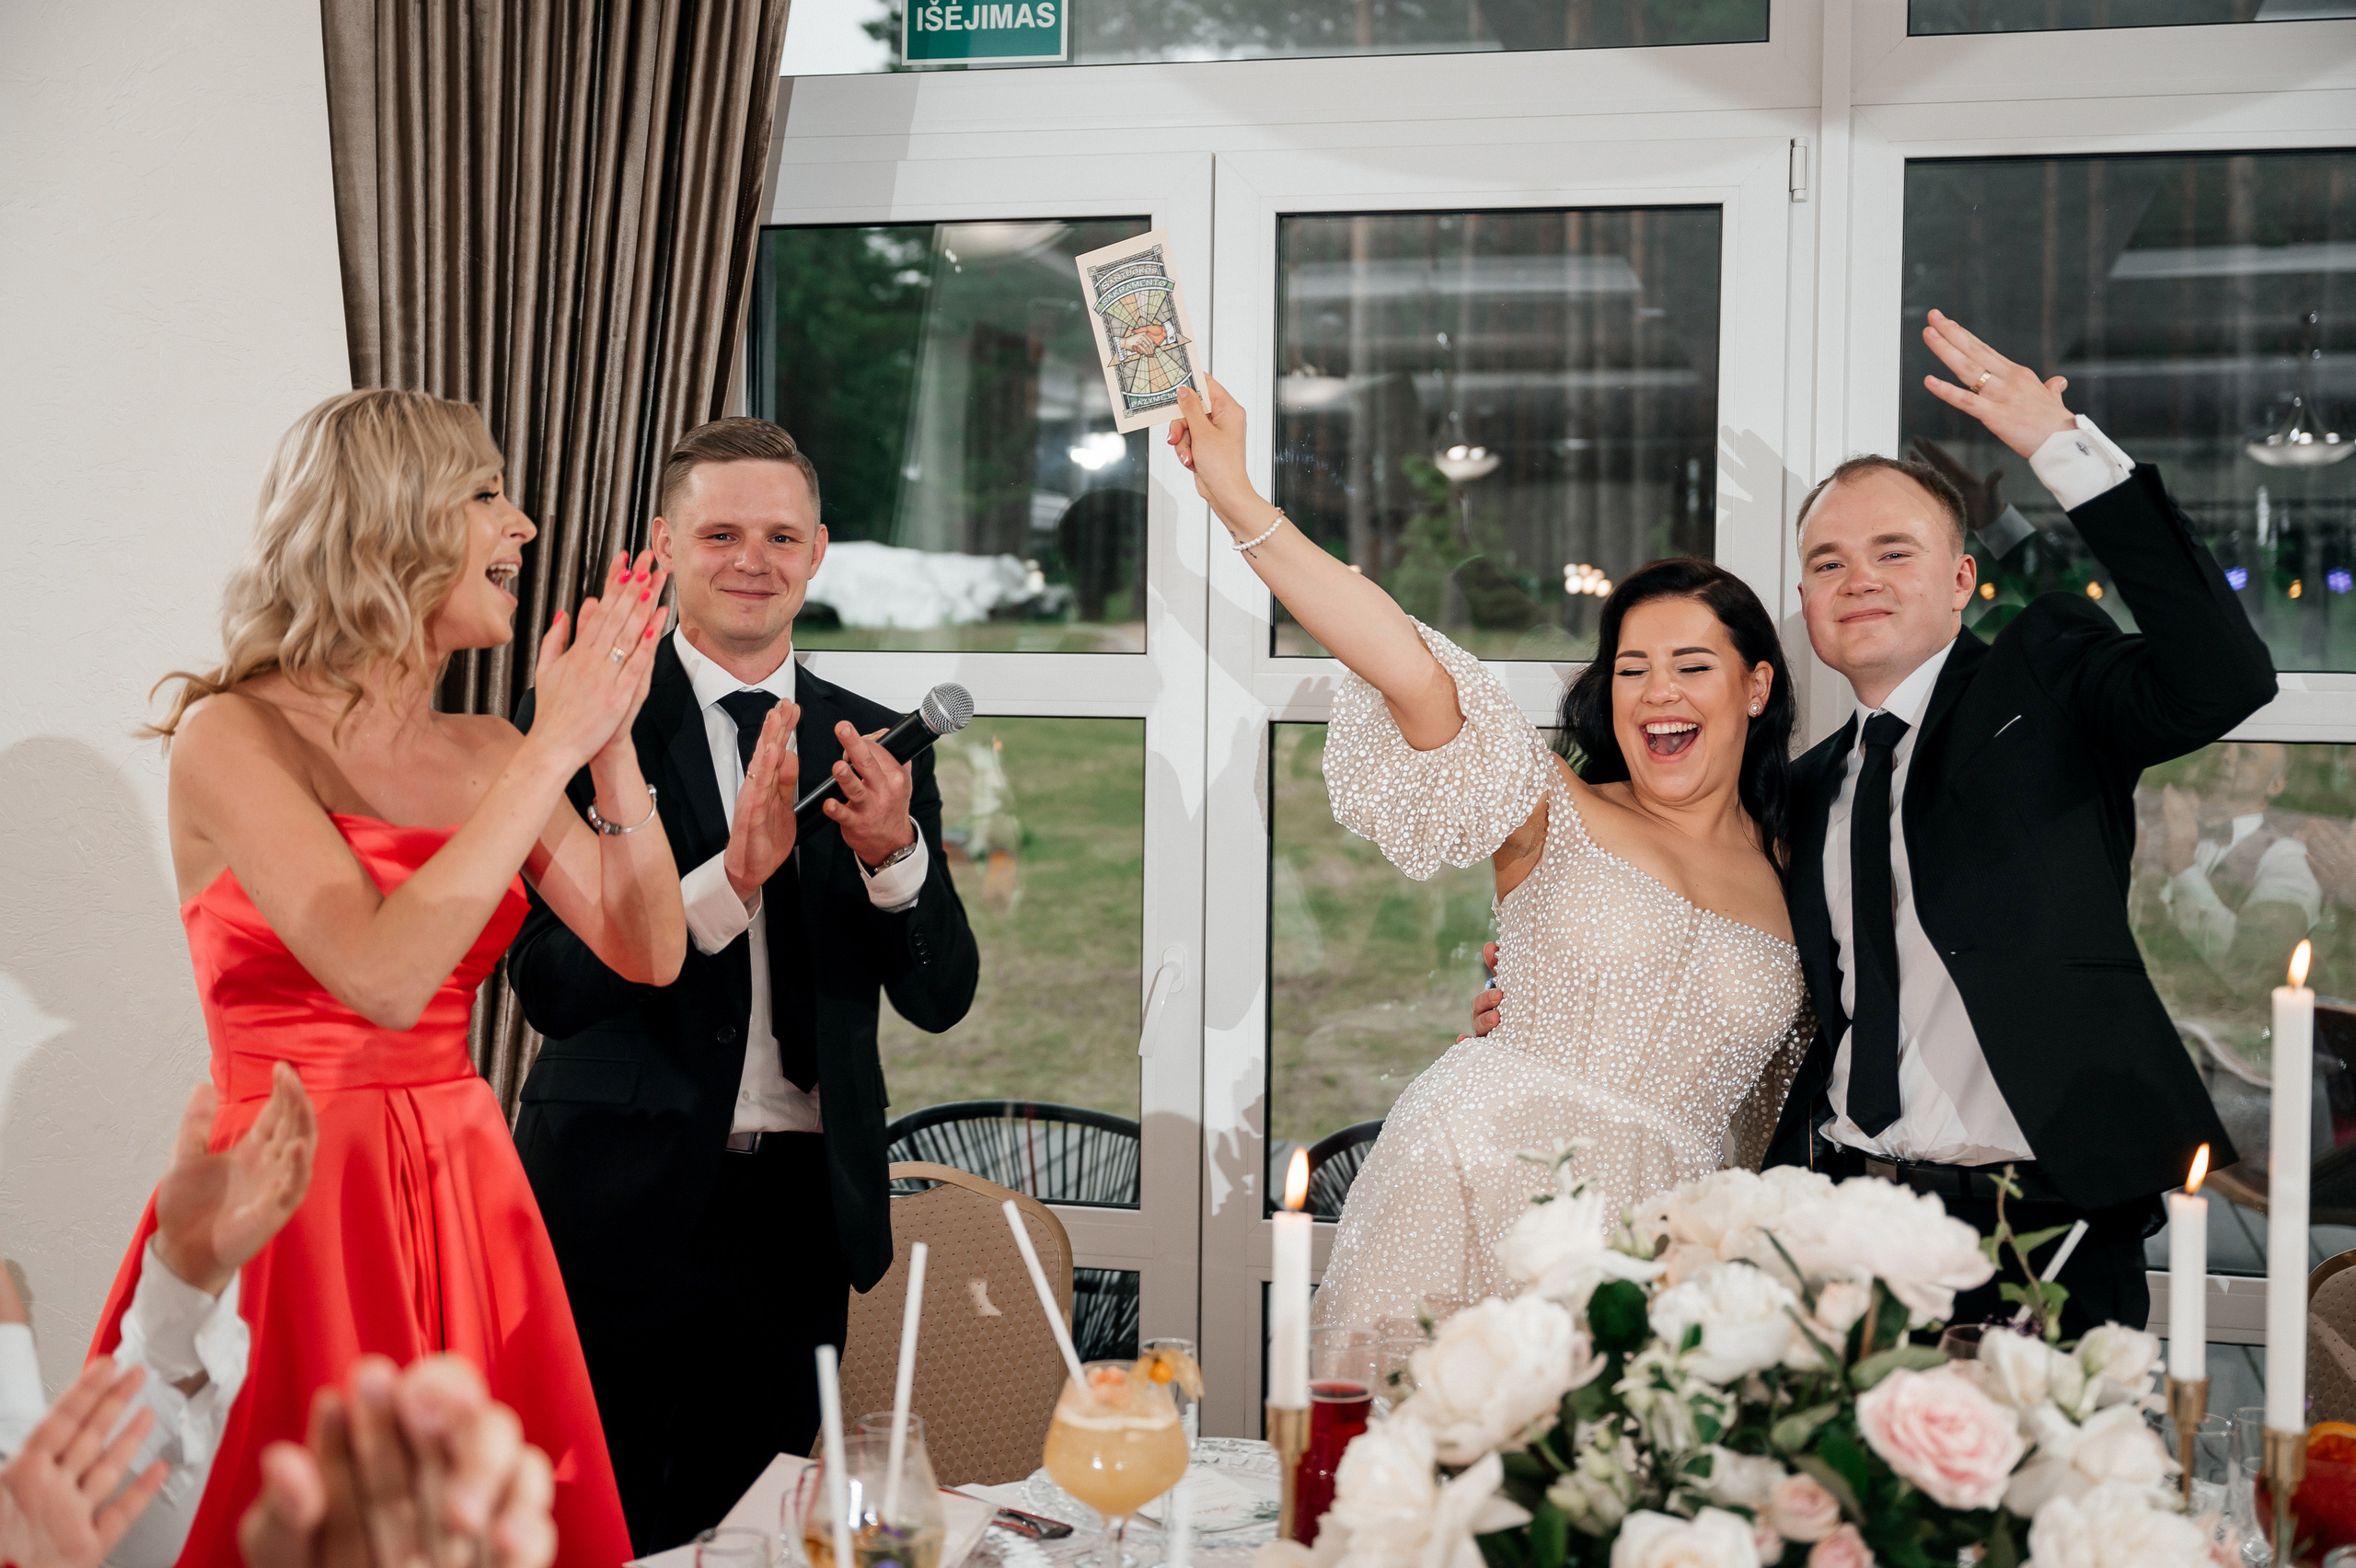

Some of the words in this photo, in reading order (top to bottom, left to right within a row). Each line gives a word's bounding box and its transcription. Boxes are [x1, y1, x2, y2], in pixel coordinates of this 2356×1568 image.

[917, 0, 1056, 31] IŠĖJIMAS
[1102, 267, 1158, 290] SANTUOKOS
[1102, 280, 1166, 306] SAKRAMENTO
